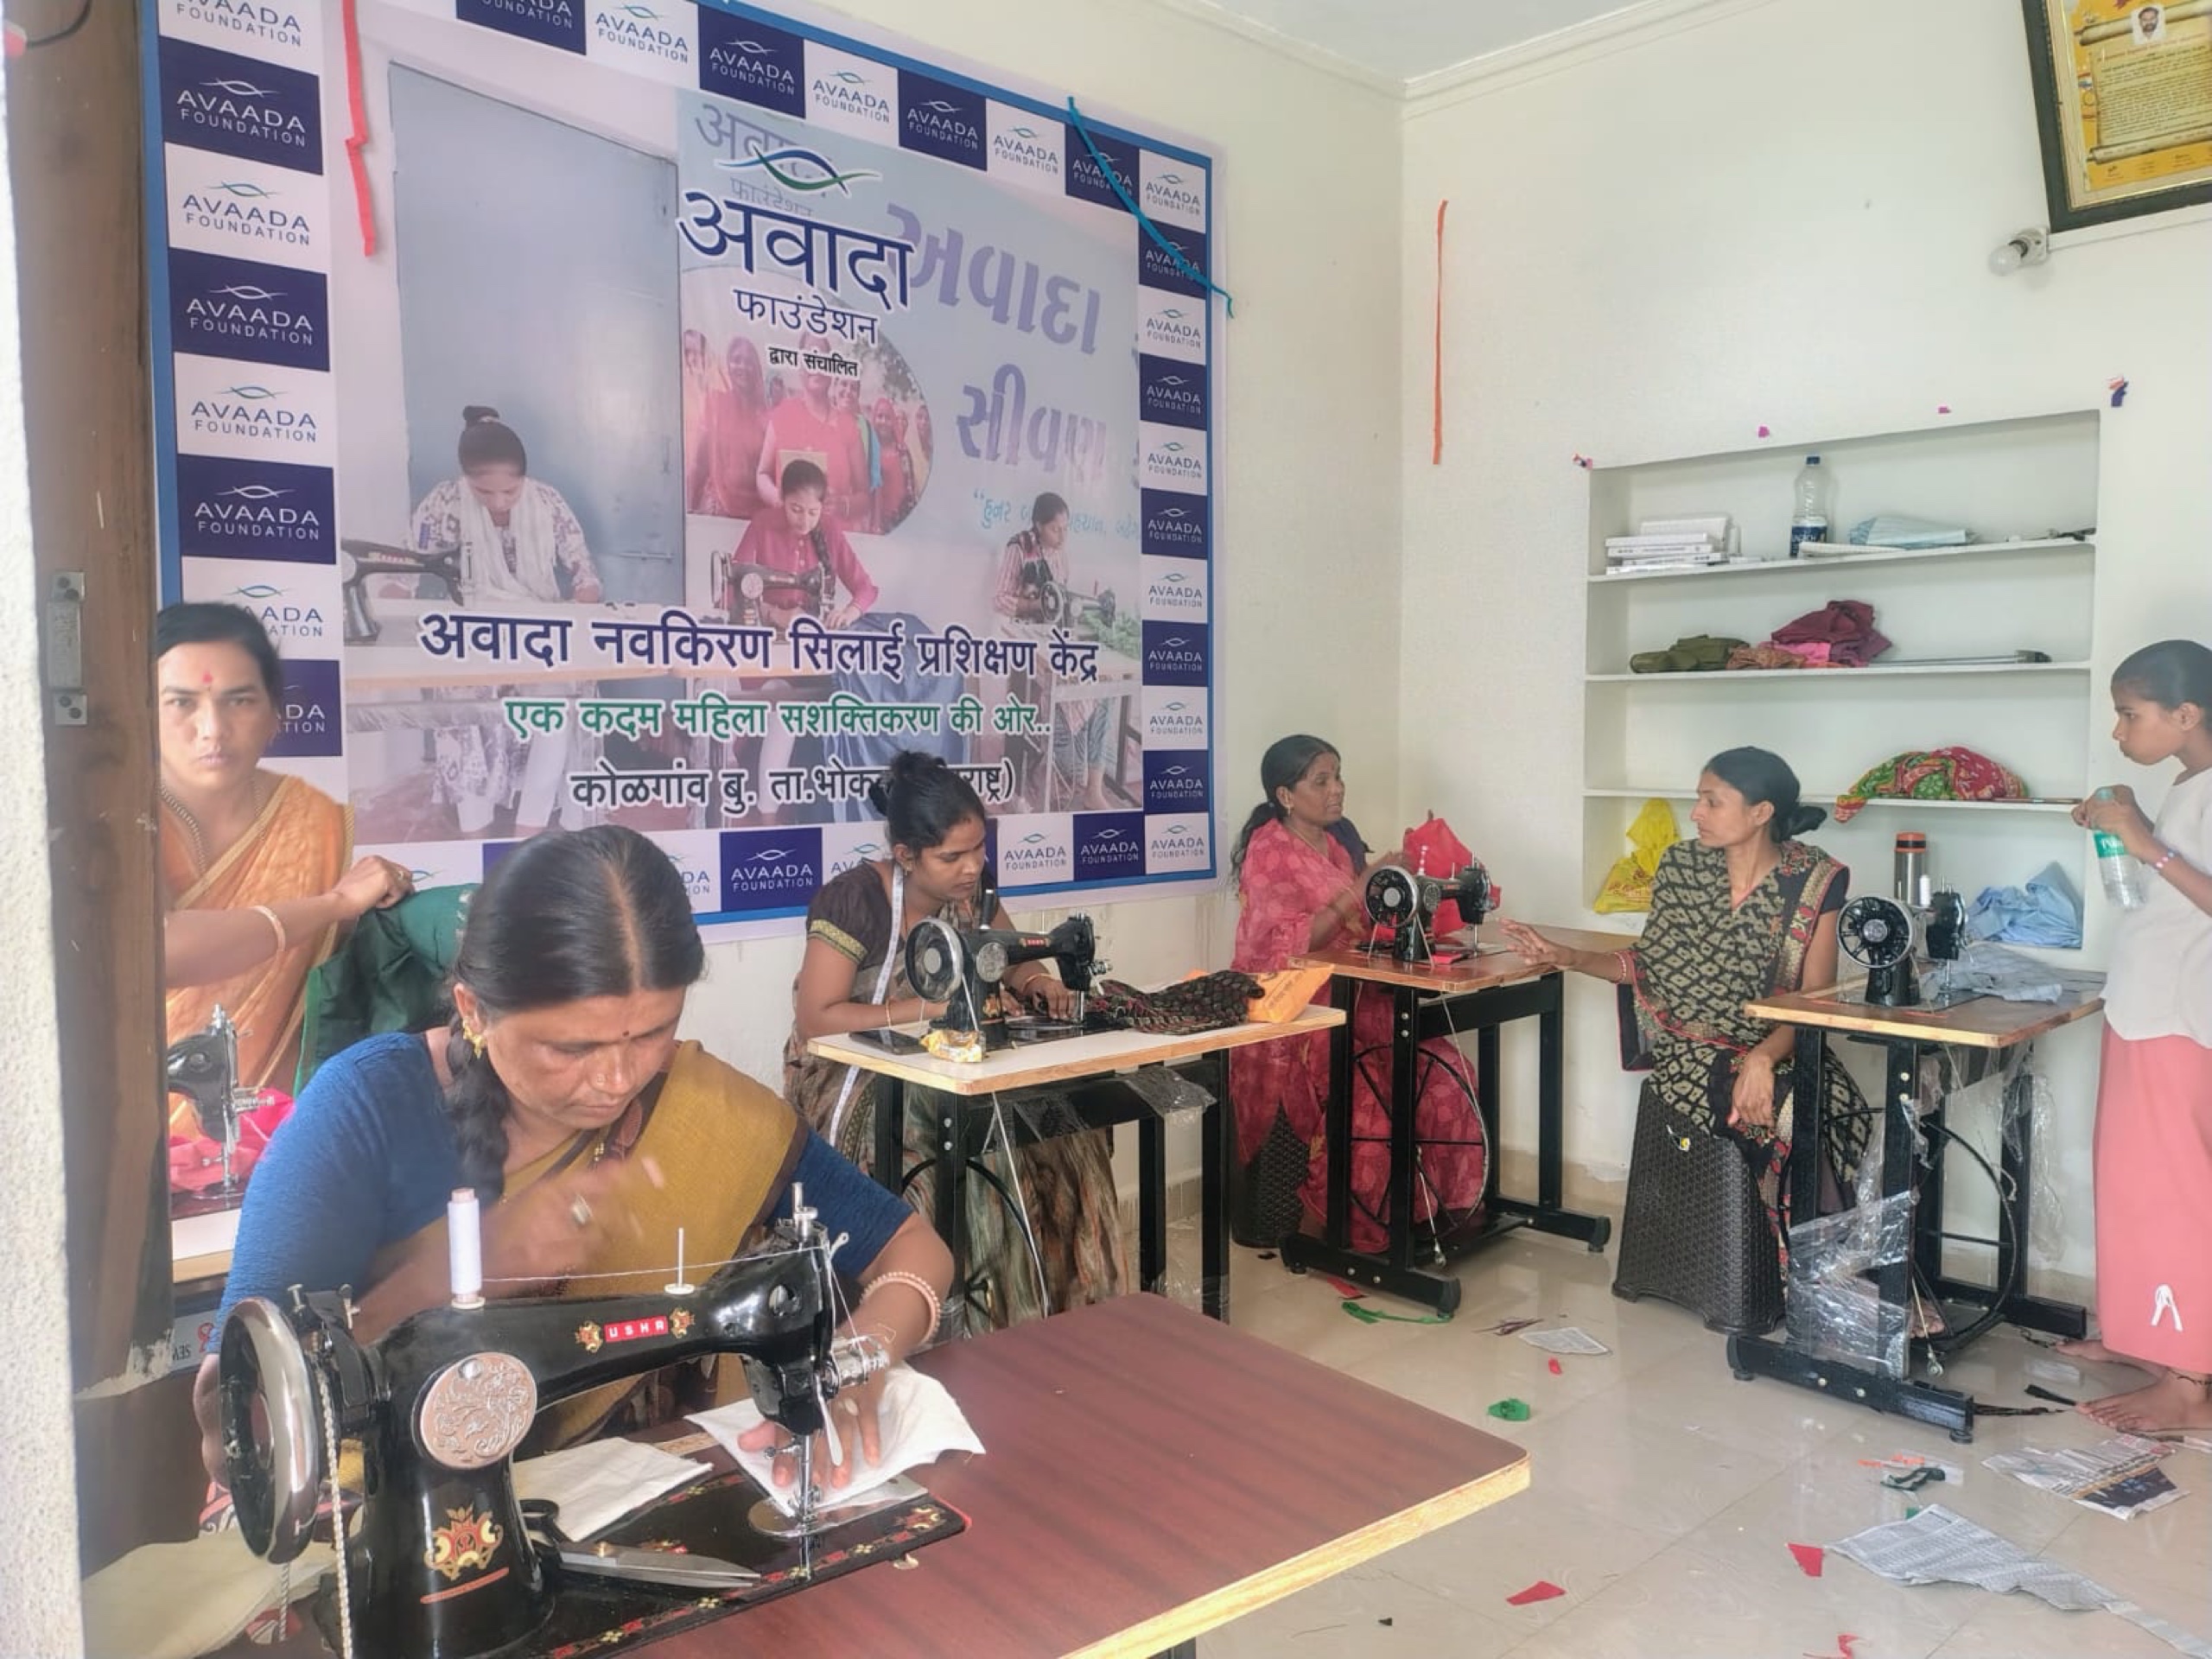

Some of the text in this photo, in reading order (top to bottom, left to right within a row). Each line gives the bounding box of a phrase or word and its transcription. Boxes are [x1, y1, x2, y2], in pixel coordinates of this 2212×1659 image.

[176, 3, 301, 47] FOUNDATION
[200, 0, 301, 32] AADA
[483, 0, 572, 29] UNDATION
[596, 13, 688, 51] AVAADA
[599, 28, 688, 64] FOUNDATION
[709, 48, 794, 83] AVAADA
[712, 62, 794, 95] FOUNDATION
[812, 79, 890, 112] AVAADA
[176, 90, 306, 133] AVAADA
[815, 95, 890, 123] FOUNDATION
[181, 108, 306, 148] FOUNDATION
[907, 108, 978, 140] AVAADA
[909, 122, 978, 150] FOUNDATION
[994, 135, 1058, 163] AVAADA
[995, 149, 1058, 175] FOUNDATION
[1073, 159, 1133, 188] AVADA
[1146, 181, 1200, 206] AVAADA
[1147, 195, 1200, 215] FOUNDATION
[183, 194, 309, 232] AVAADA
[187, 213, 309, 245] FOUNDATION
[680, 192, 914, 309] अवादा
[187, 298, 313, 331] AVAADA
[734, 289, 878, 344] फाउंडेशन
[190, 317, 313, 346] FOUNDATION
[1146, 318, 1200, 340] AVAADA
[1147, 330, 1200, 349] FOUNDATION
[769, 346, 858, 377] द्वारा संचालित
[1147, 385, 1201, 404] AVAADA
[1147, 397, 1201, 415] FOUNDATION
[191, 401, 316, 429] AVAADA
[194, 419, 316, 442] FOUNDATION
[1147, 452, 1202, 470] AVAADA
[1148, 465, 1202, 480] FOUNDATION
[194, 502, 320, 526] AVAADA
[198, 521, 319, 541] FOUNDATION
[1147, 518, 1202, 534] AVAADA
[1149, 531, 1202, 543] FOUNDATION
[1148, 586, 1202, 599] AVAADA
[1150, 596, 1202, 608] FOUNDATION
[267, 625, 323, 637] ATION
[422, 610, 1099, 682] अवादा नवकिरण सिलाई प्रशिक्षण केंद्र
[1148, 650, 1202, 663] AVAADA
[1150, 663, 1202, 671] FOUNDATION
[505, 692, 1051, 739] एक कदम महिला सशक्तिकरण की ओर..
[1150, 715, 1203, 727] AVAADA
[1151, 726, 1203, 735] FOUNDATION
[570, 760, 709, 806] कोळगांव
[721, 773, 754, 813] बु.
[1150, 779, 1203, 791] AVAADA
[1151, 790, 1203, 799] FOUNDATION
[1004, 846, 1067, 861] AVAADA
[1080, 841, 1139, 856] AVAADA
[1152, 836, 1205, 850] AVAADA
[1153, 849, 1205, 859] FOUNDATION
[1006, 858, 1067, 870] FOUNDATION
[1082, 854, 1139, 865] FOUNDATION
[731, 863, 813, 881] AVAADA
[733, 877, 813, 893] FOUNDATION
[608, 1319, 664, 1338] USHA
